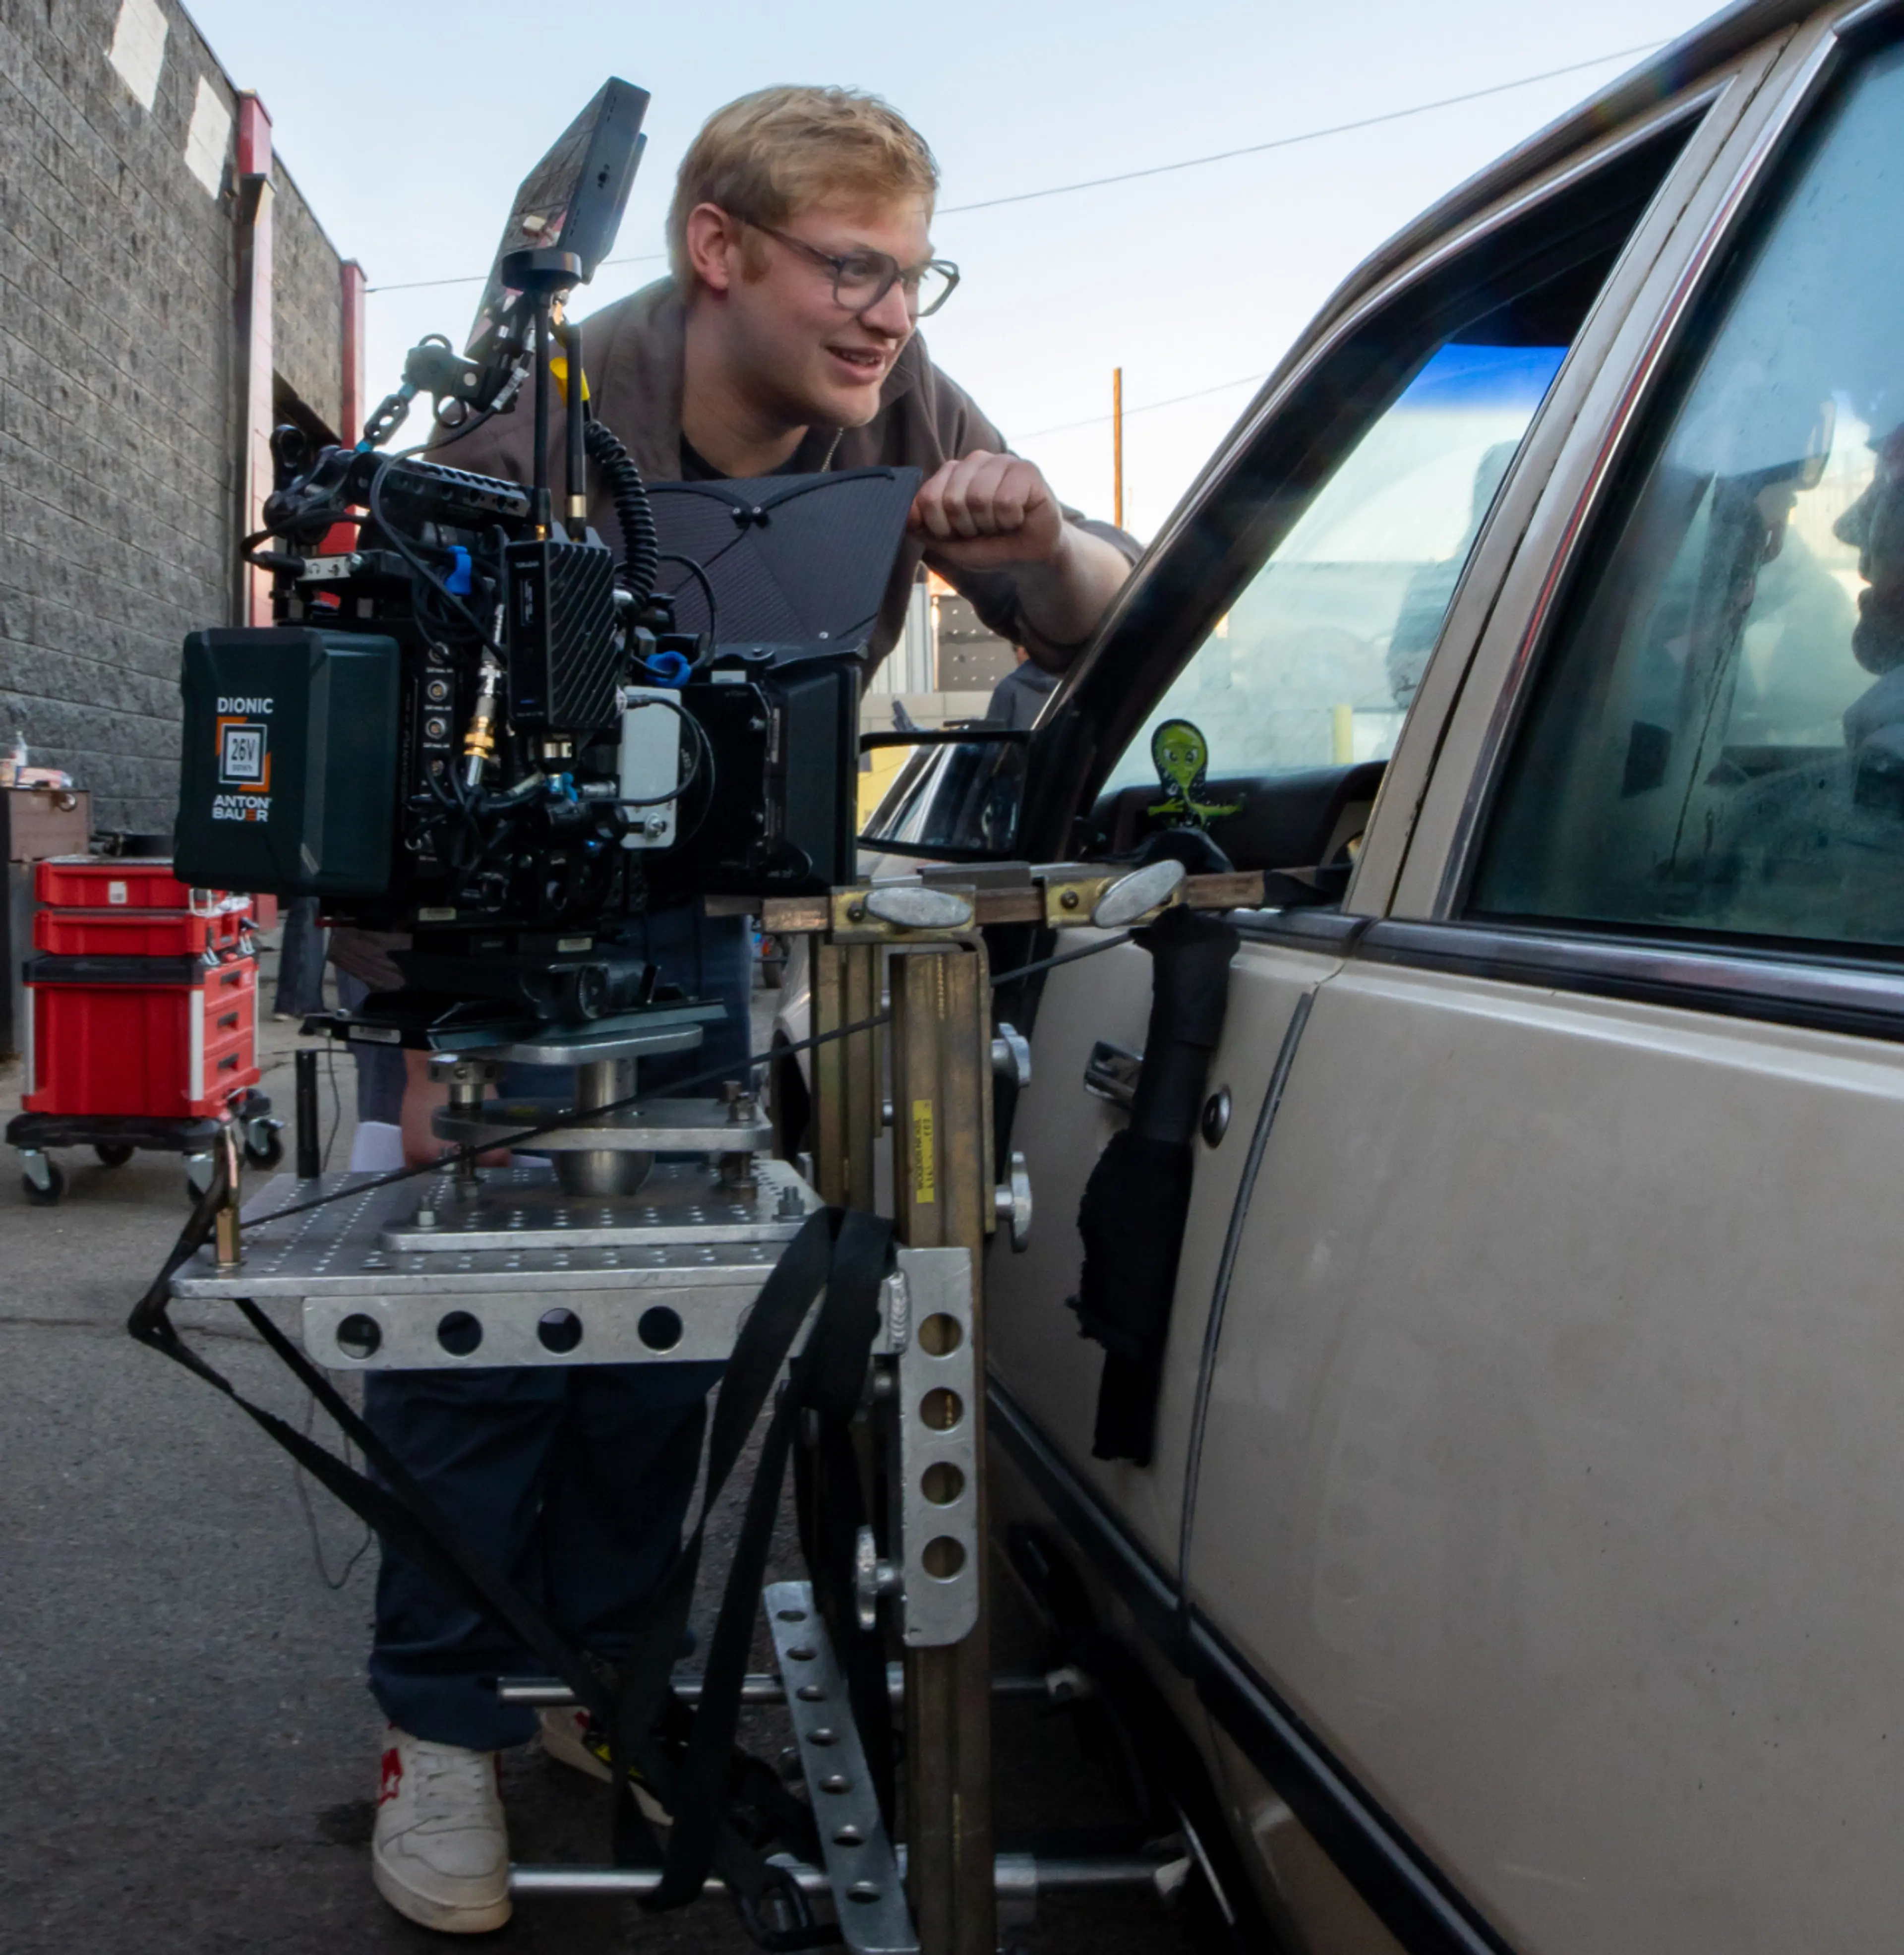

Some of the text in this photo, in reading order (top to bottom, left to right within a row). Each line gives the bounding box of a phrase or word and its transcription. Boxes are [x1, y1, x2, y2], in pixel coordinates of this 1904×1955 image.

[217, 697, 273, 713] DIONIC
[231, 738, 255, 761] 26V
[213, 794, 271, 809] ANTON
[212, 807, 268, 822] BAUER
